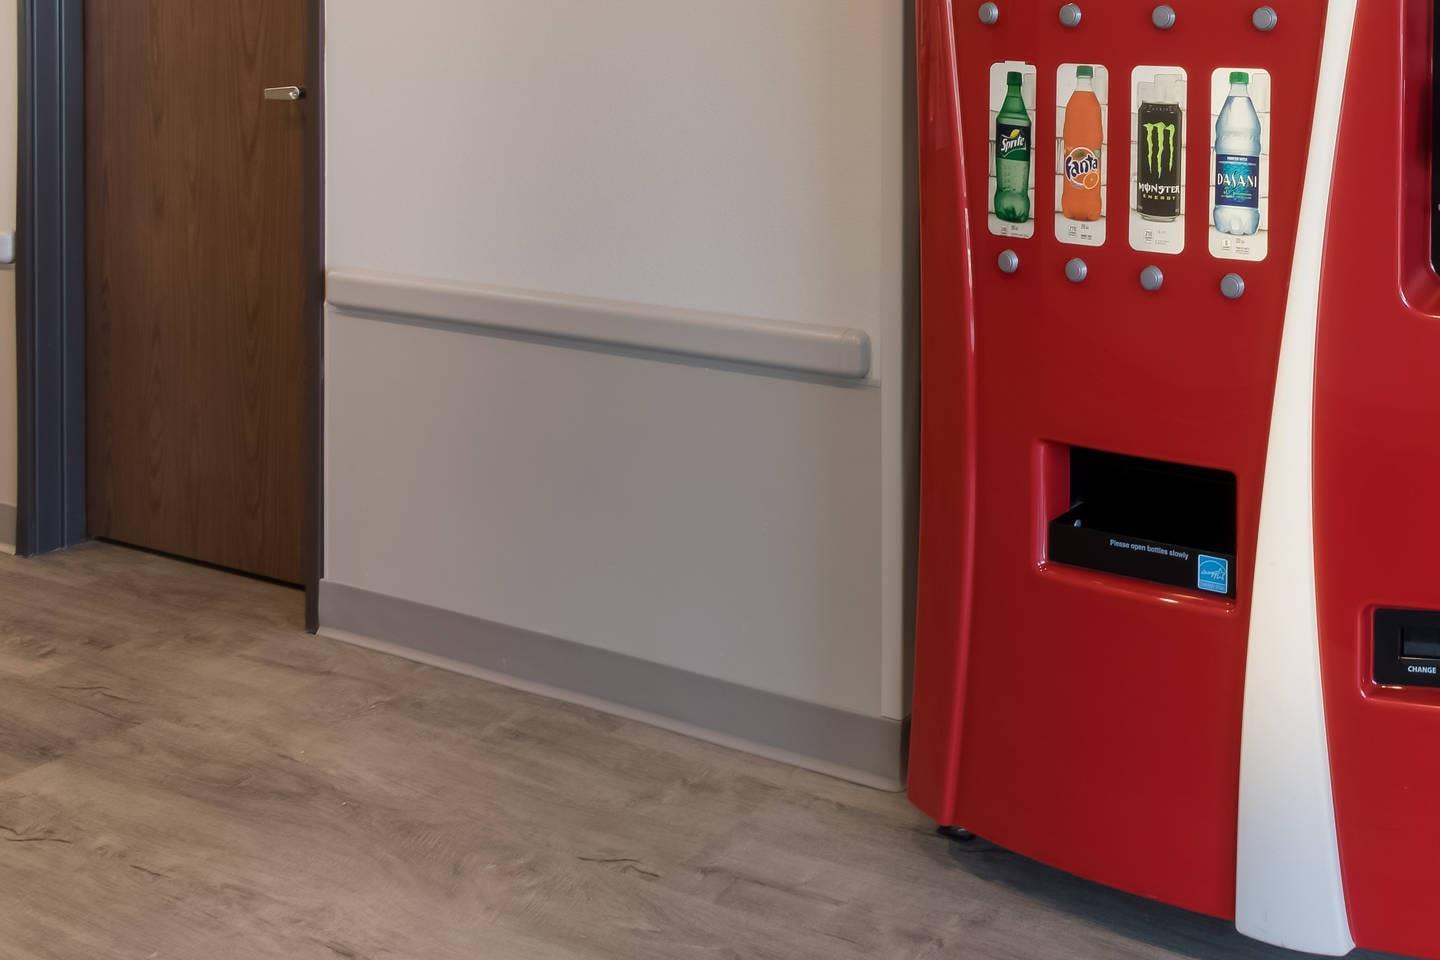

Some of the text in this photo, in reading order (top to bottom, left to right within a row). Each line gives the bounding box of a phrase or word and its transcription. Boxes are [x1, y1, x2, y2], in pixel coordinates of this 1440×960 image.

[1001, 135, 1025, 152] Sprite
[1217, 172, 1257, 188] DASANI
[1139, 183, 1179, 195] MONSTER
[1110, 539, 1189, 561] Please open bottles slowly
[1407, 665, 1437, 674] CHANGE
